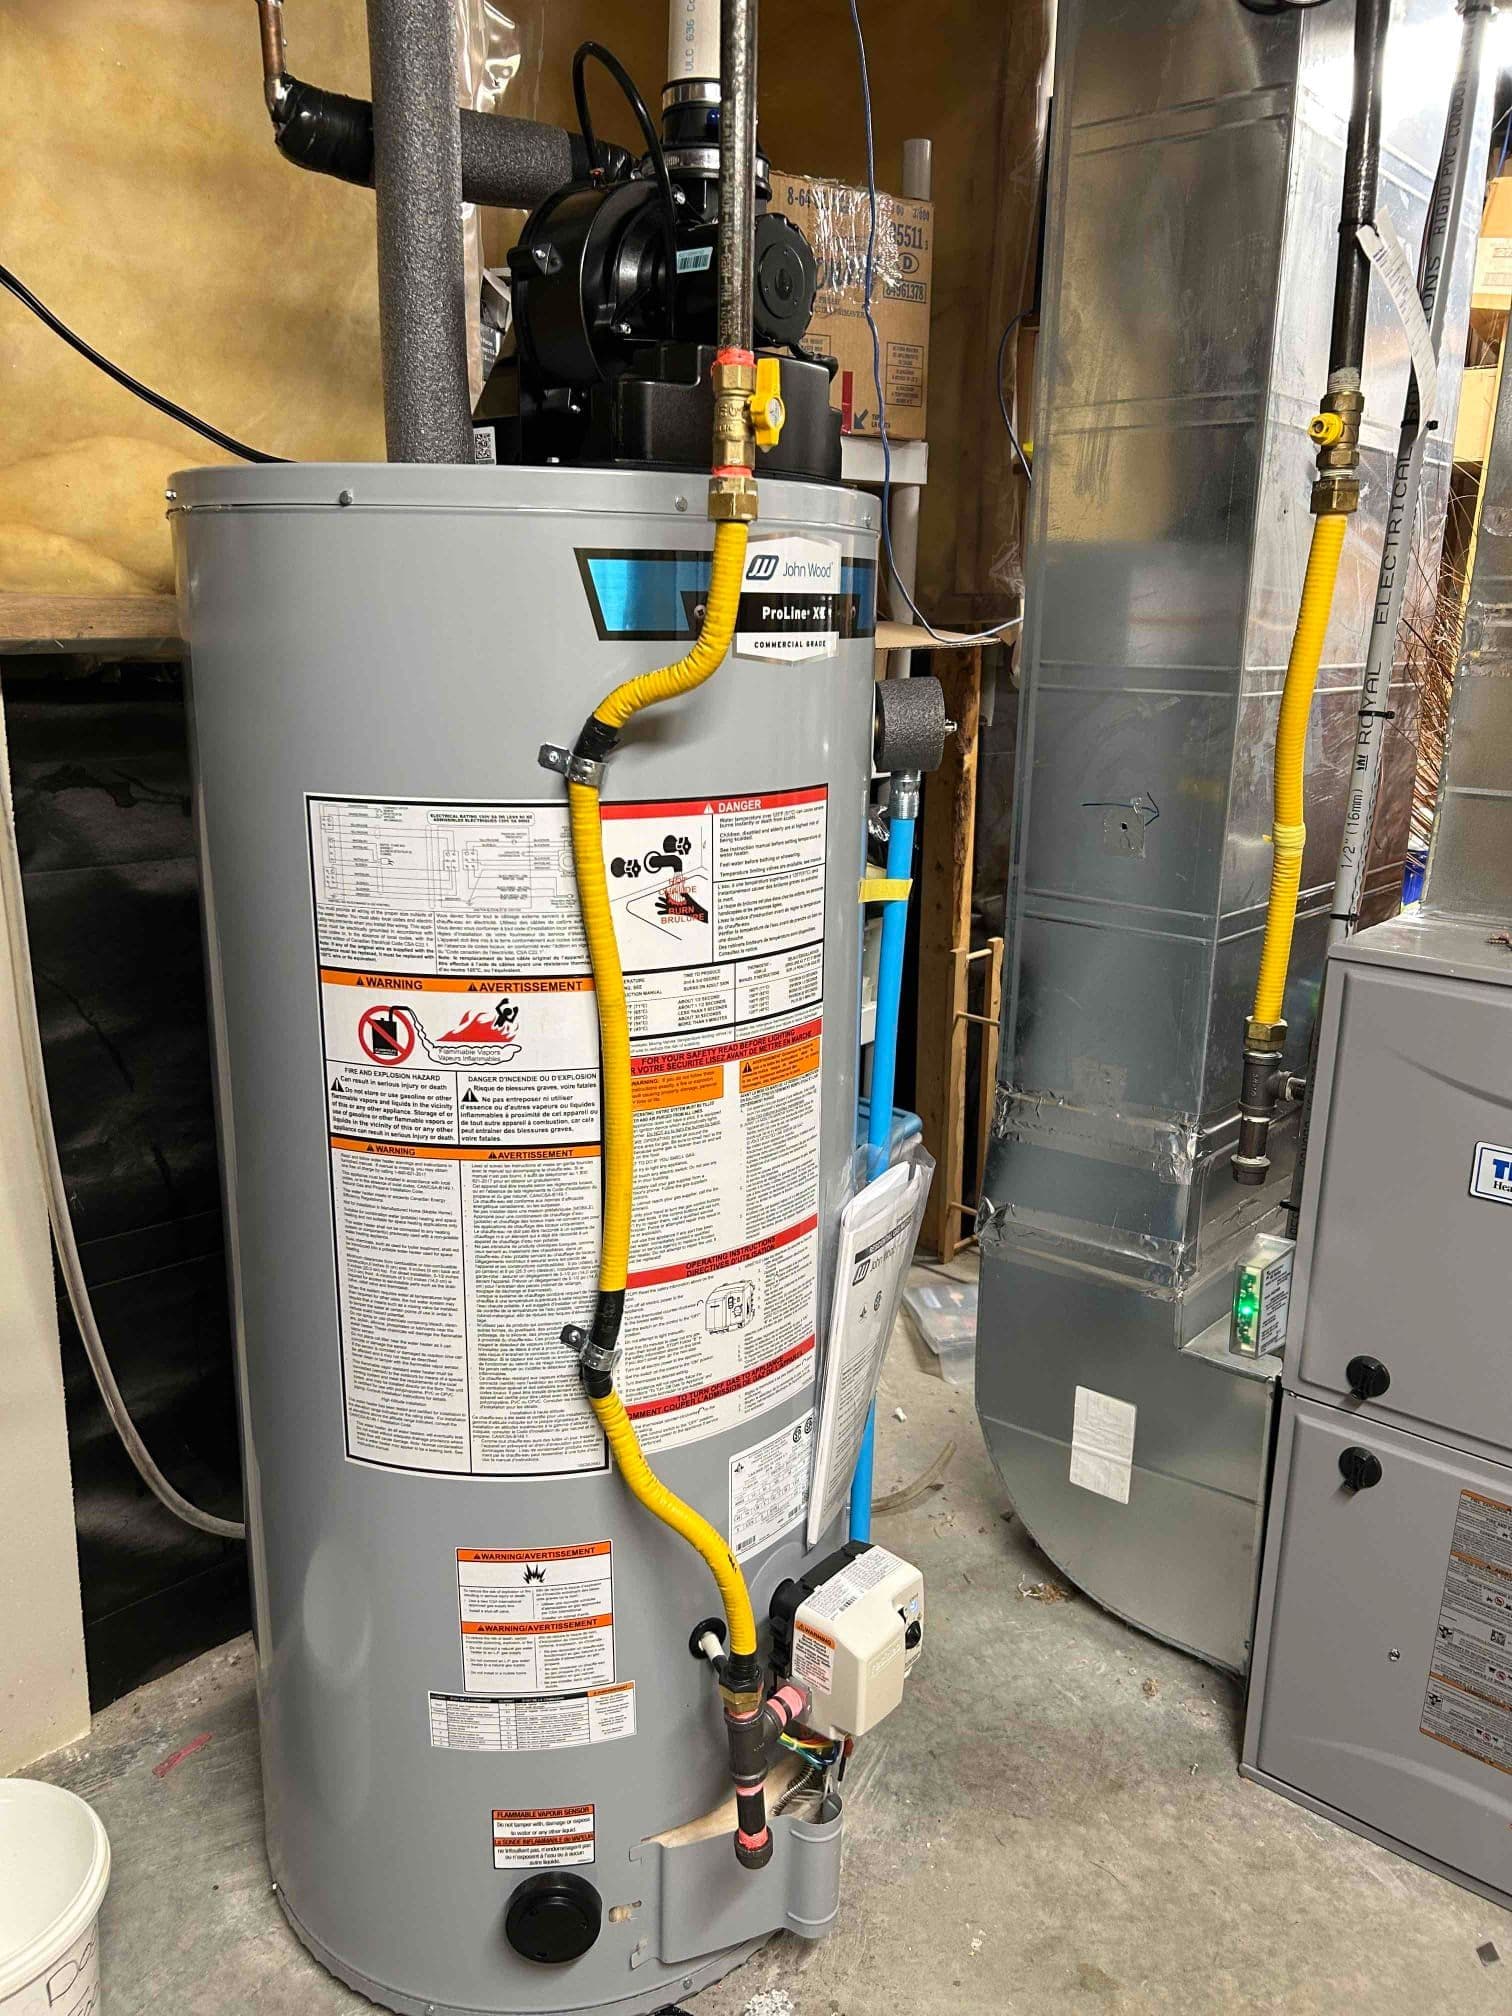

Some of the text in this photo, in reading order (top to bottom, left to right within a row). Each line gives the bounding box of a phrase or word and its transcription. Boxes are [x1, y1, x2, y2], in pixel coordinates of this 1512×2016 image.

[1346, 788, 1363, 835] (16mm)
[1358, 661, 1382, 746] ROYAL
[1377, 445, 1412, 625] ELECTRICAL
[1433, 186, 1452, 236] RIGID
[783, 561, 832, 578] John Wood
[762, 605, 807, 620] ProLine
[754, 640, 826, 649] COMMERCIAL GRADE
[719, 800, 761, 813] DANGER
[669, 905, 694, 914] BURN
[366, 976, 423, 990] WARNING
[480, 981, 583, 993] AVERTISSEMENT
[687, 1048, 715, 1057] SAFETY
[719, 1042, 738, 1054] READ
[740, 1037, 766, 1050] BEFORE
[768, 1030, 795, 1042] LIGHTING
[439, 1048, 476, 1056] Flammable
[637, 1064, 665, 1073] VOTRE
[667, 1058, 703, 1070] SECURITE
[706, 1055, 725, 1064] LISEZ
[727, 1050, 747, 1060] AVANT
[759, 1040, 782, 1052] METTRE
[792, 1030, 811, 1042] MARCHE
[345, 1067, 358, 1075] FIRE
[373, 1071, 410, 1079] EXPLOSION
[552, 1073, 596, 1081] D'EXPLOSION
[401, 1082, 418, 1090] injury
[391, 1100, 411, 1108] liquids
[376, 1145, 416, 1156] WARNING
[498, 1150, 573, 1160] AVERTISSEMENT
[686, 1236, 776, 1270] OPERATING INSTRUCTIONS
[687, 1245, 774, 1277] DIRECTIVES D'UTILISATION
[689, 1388, 709, 1399] TURN
[711, 1382, 724, 1392] OFF
[726, 1377, 740, 1386] GAS
[752, 1356, 784, 1377] APPLIANCE
[663, 1399, 696, 1412] COUPER
[752, 1372, 766, 1383] GAZ
[481, 1547, 595, 1560] WARNING/AVERTISSEMENT
[484, 1619, 598, 1632] WARNING/AVERTISSEMENT
[804, 1626, 832, 1647] WARNING
[565, 1806, 590, 1815] SENSOR
